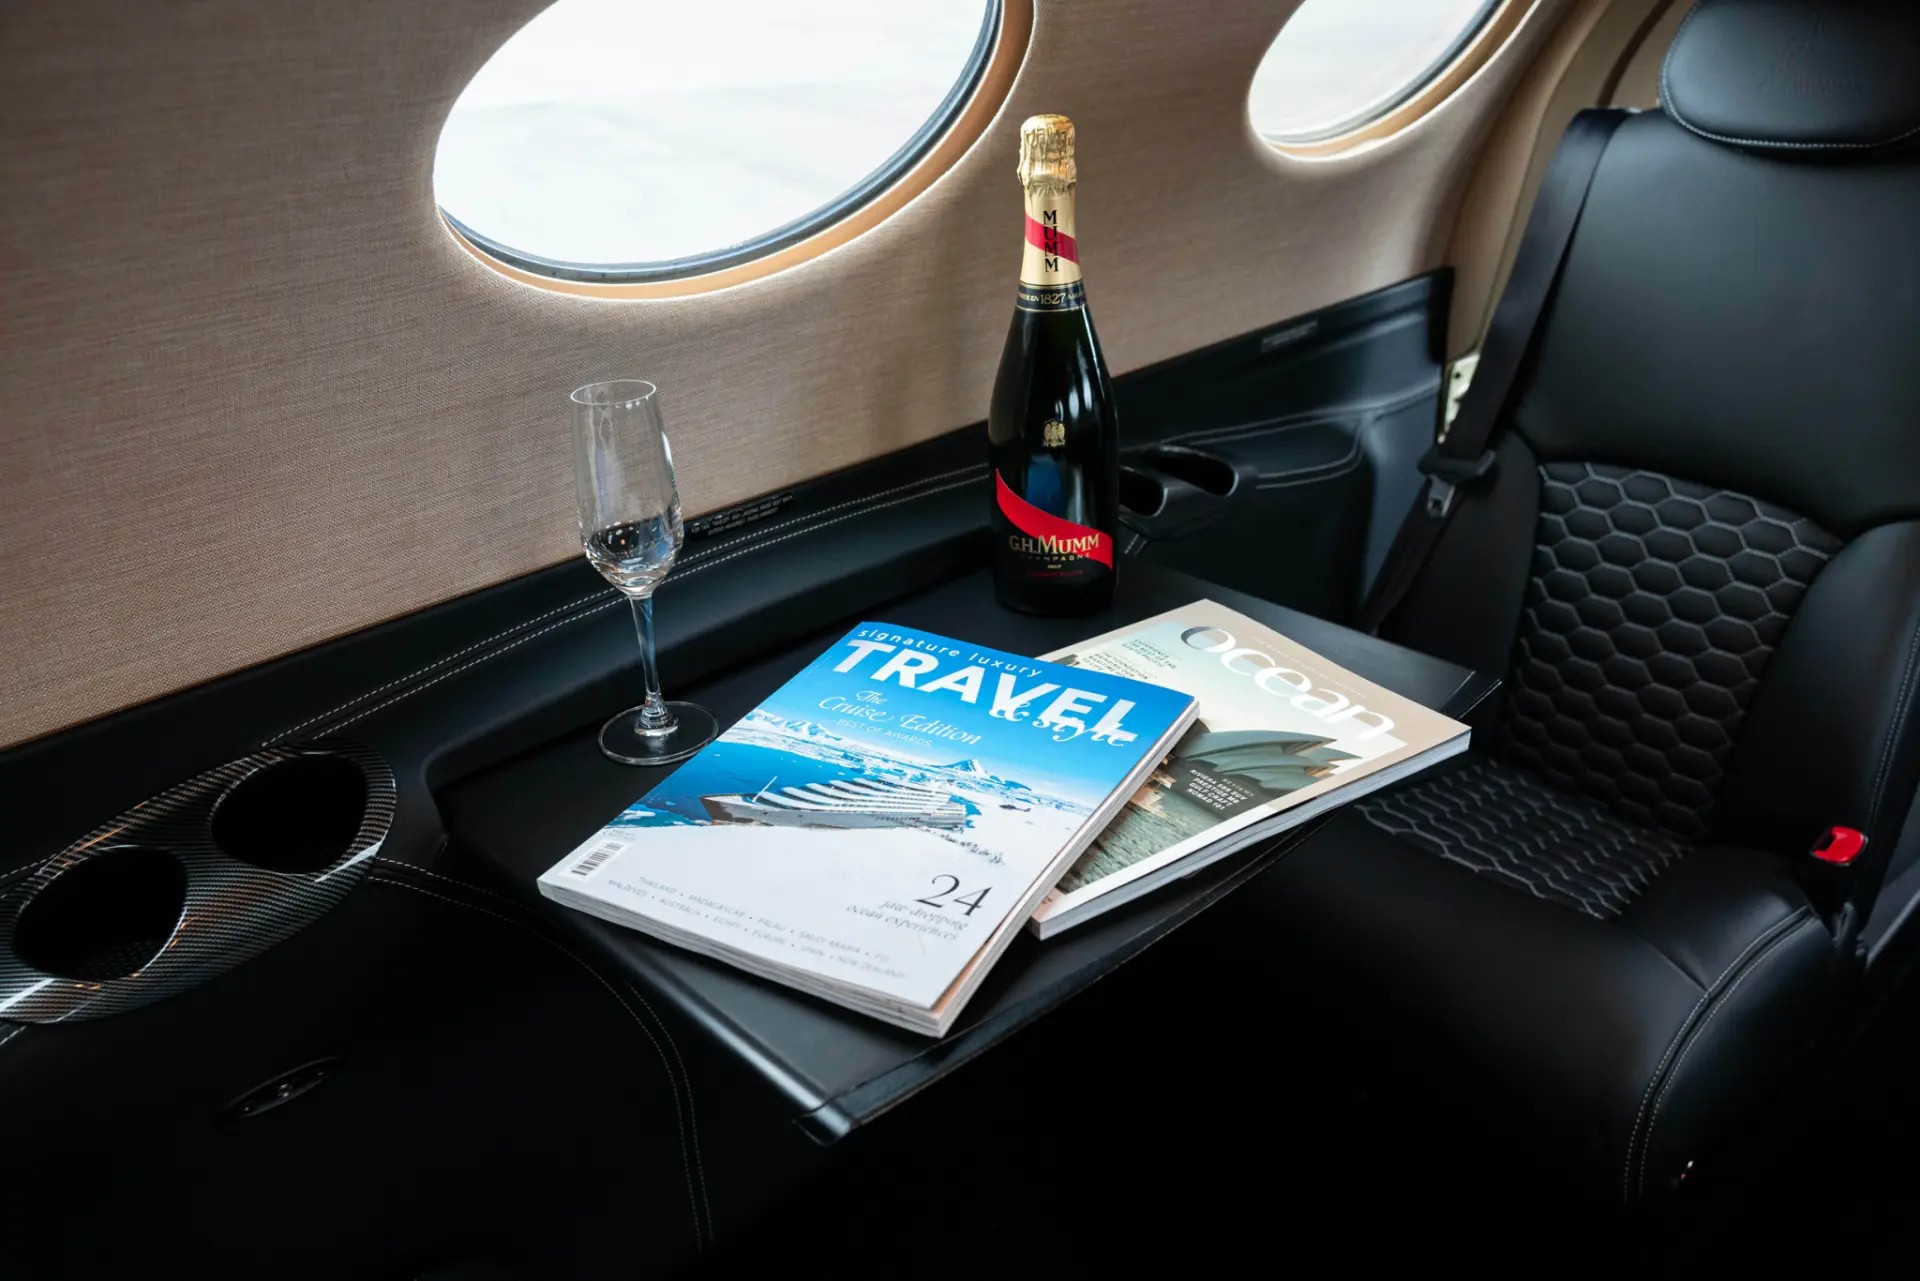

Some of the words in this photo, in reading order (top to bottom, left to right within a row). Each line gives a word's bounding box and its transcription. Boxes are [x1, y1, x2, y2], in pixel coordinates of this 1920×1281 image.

[1043, 210, 1059, 272] MUMM
[1040, 292, 1066, 304] 1827
[858, 628, 960, 658] signature
[968, 652, 1043, 679] luxury
[833, 639, 1138, 742] TRAVEL
[856, 690, 888, 705] The
[1180, 625, 1395, 742] ocean
[818, 696, 895, 722] Cruise
[900, 714, 982, 745] Edition
[838, 718, 866, 731] BEST
[866, 725, 885, 734] OF
[885, 729, 933, 747] AWARDS
[1189, 769, 1217, 785] RIVIERA
[1193, 778, 1228, 798] PRESTIGE
[1188, 782, 1207, 795] GULF
[1207, 791, 1233, 807] CRAFT
[914, 874, 993, 916] 24
[884, 917, 957, 940] experiences
